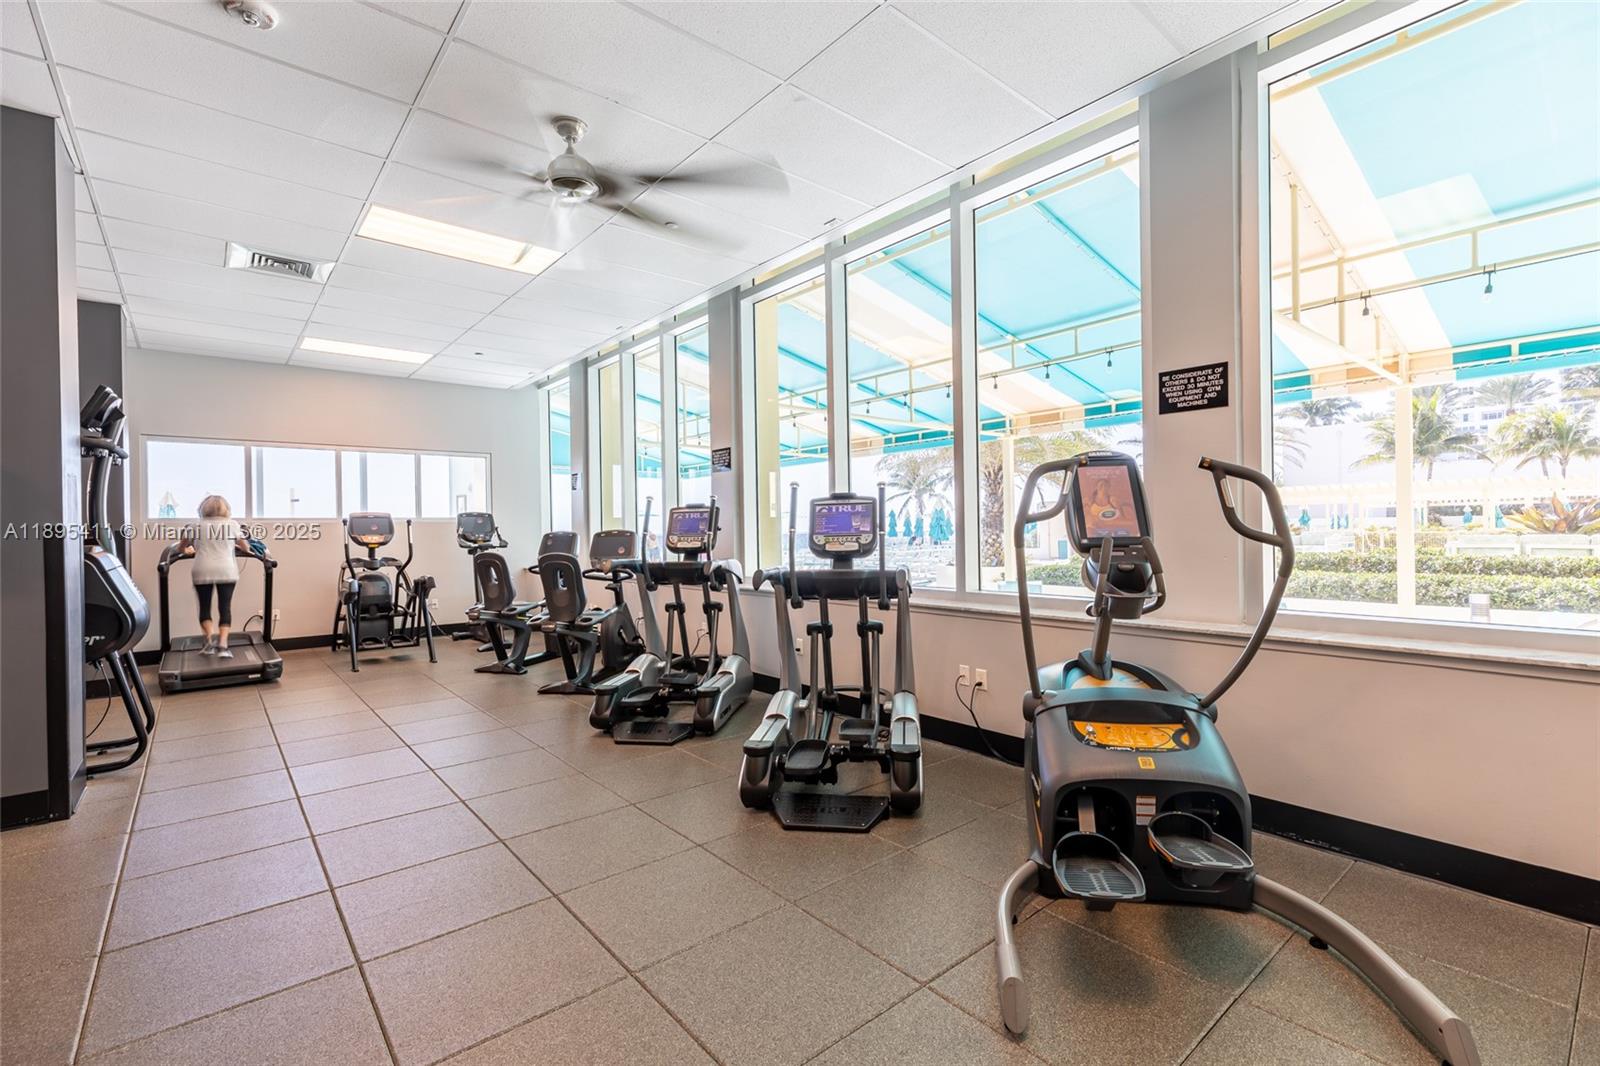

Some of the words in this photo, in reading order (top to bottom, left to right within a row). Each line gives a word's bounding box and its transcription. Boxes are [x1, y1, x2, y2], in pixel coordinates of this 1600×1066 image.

[1172, 369, 1213, 380] CONSIDERATE
[1196, 379, 1224, 388] MINUTES
[1168, 394, 1202, 403] EQUIPMENT
[1177, 399, 1208, 408] MACHINES
